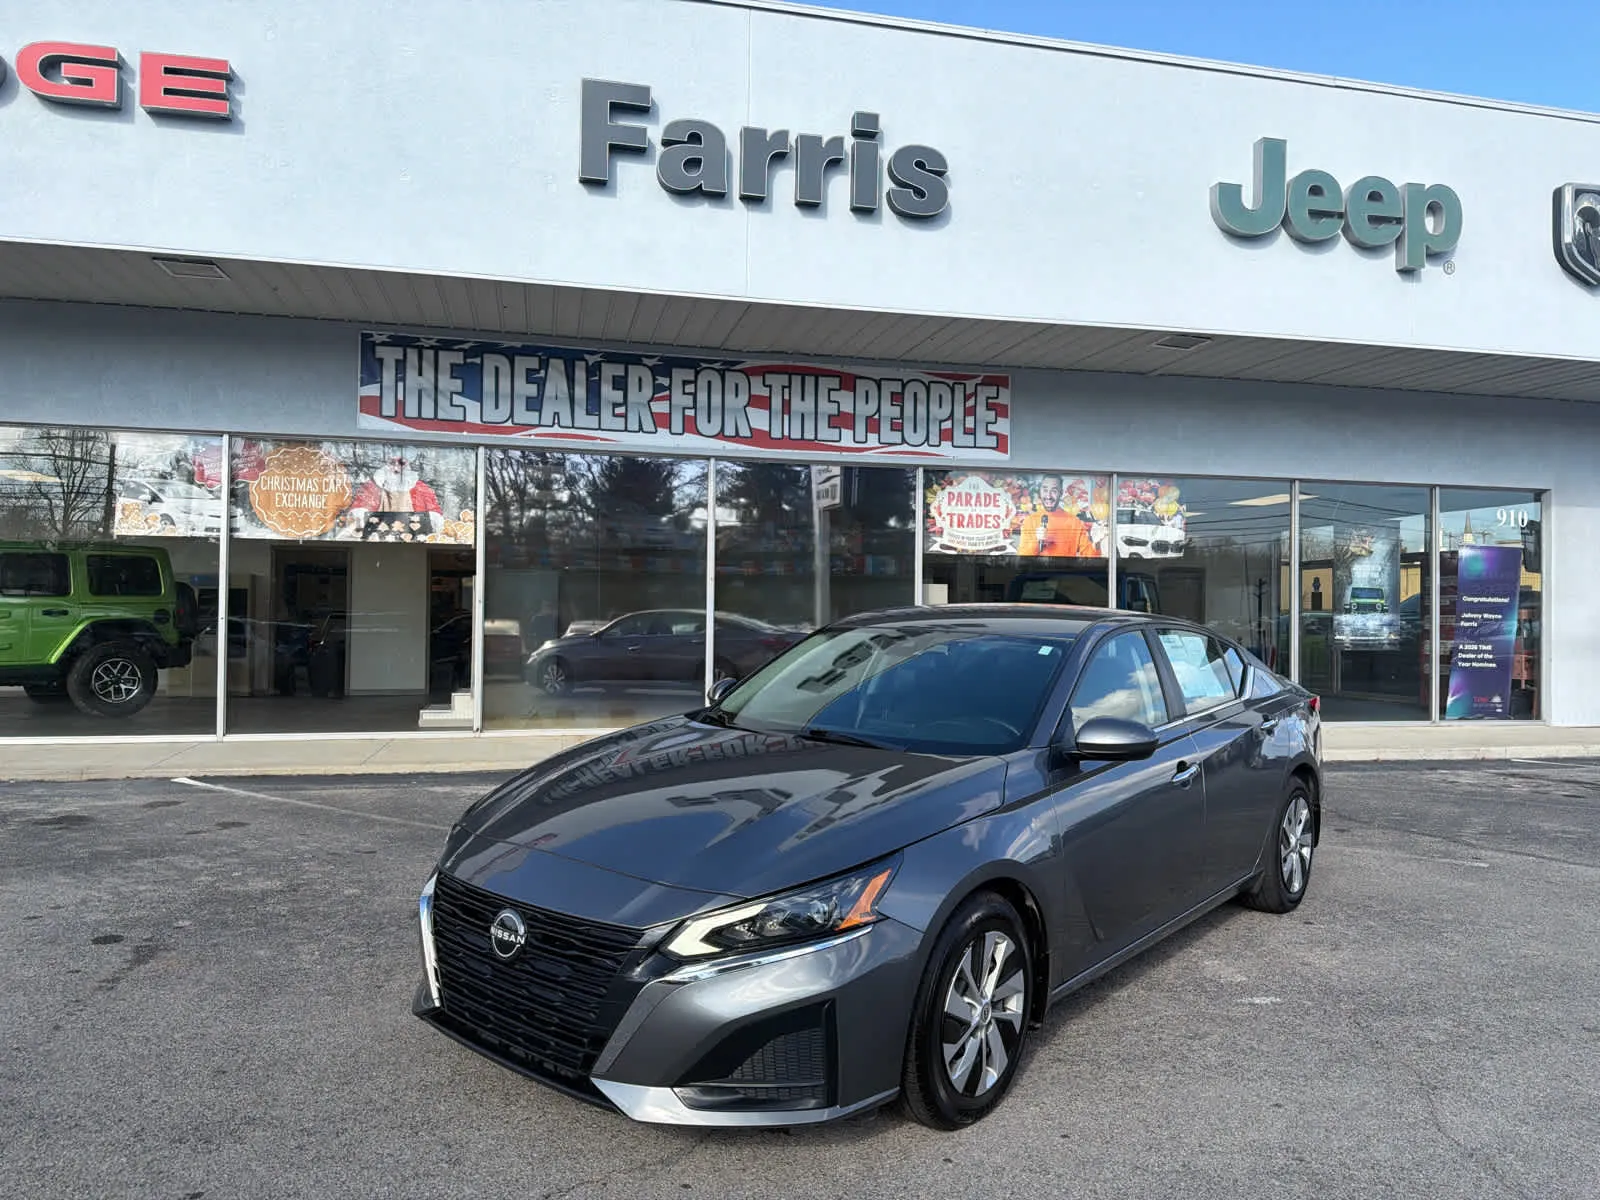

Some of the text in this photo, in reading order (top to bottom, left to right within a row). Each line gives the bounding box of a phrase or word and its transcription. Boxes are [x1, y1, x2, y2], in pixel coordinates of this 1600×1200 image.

[0, 41, 232, 121] GE
[578, 78, 949, 218] Farris
[1210, 137, 1463, 272] Jeep
[374, 345, 999, 449] THE DEALER FOR THE PEOPLE
[260, 475, 344, 494] CHRISTMAS CAR
[275, 492, 329, 510] EXCHANGE
[947, 491, 1001, 508] PARADE
[946, 512, 1001, 529] TRADES
[1496, 508, 1529, 528] 910
[489, 924, 526, 945] NISSAN
